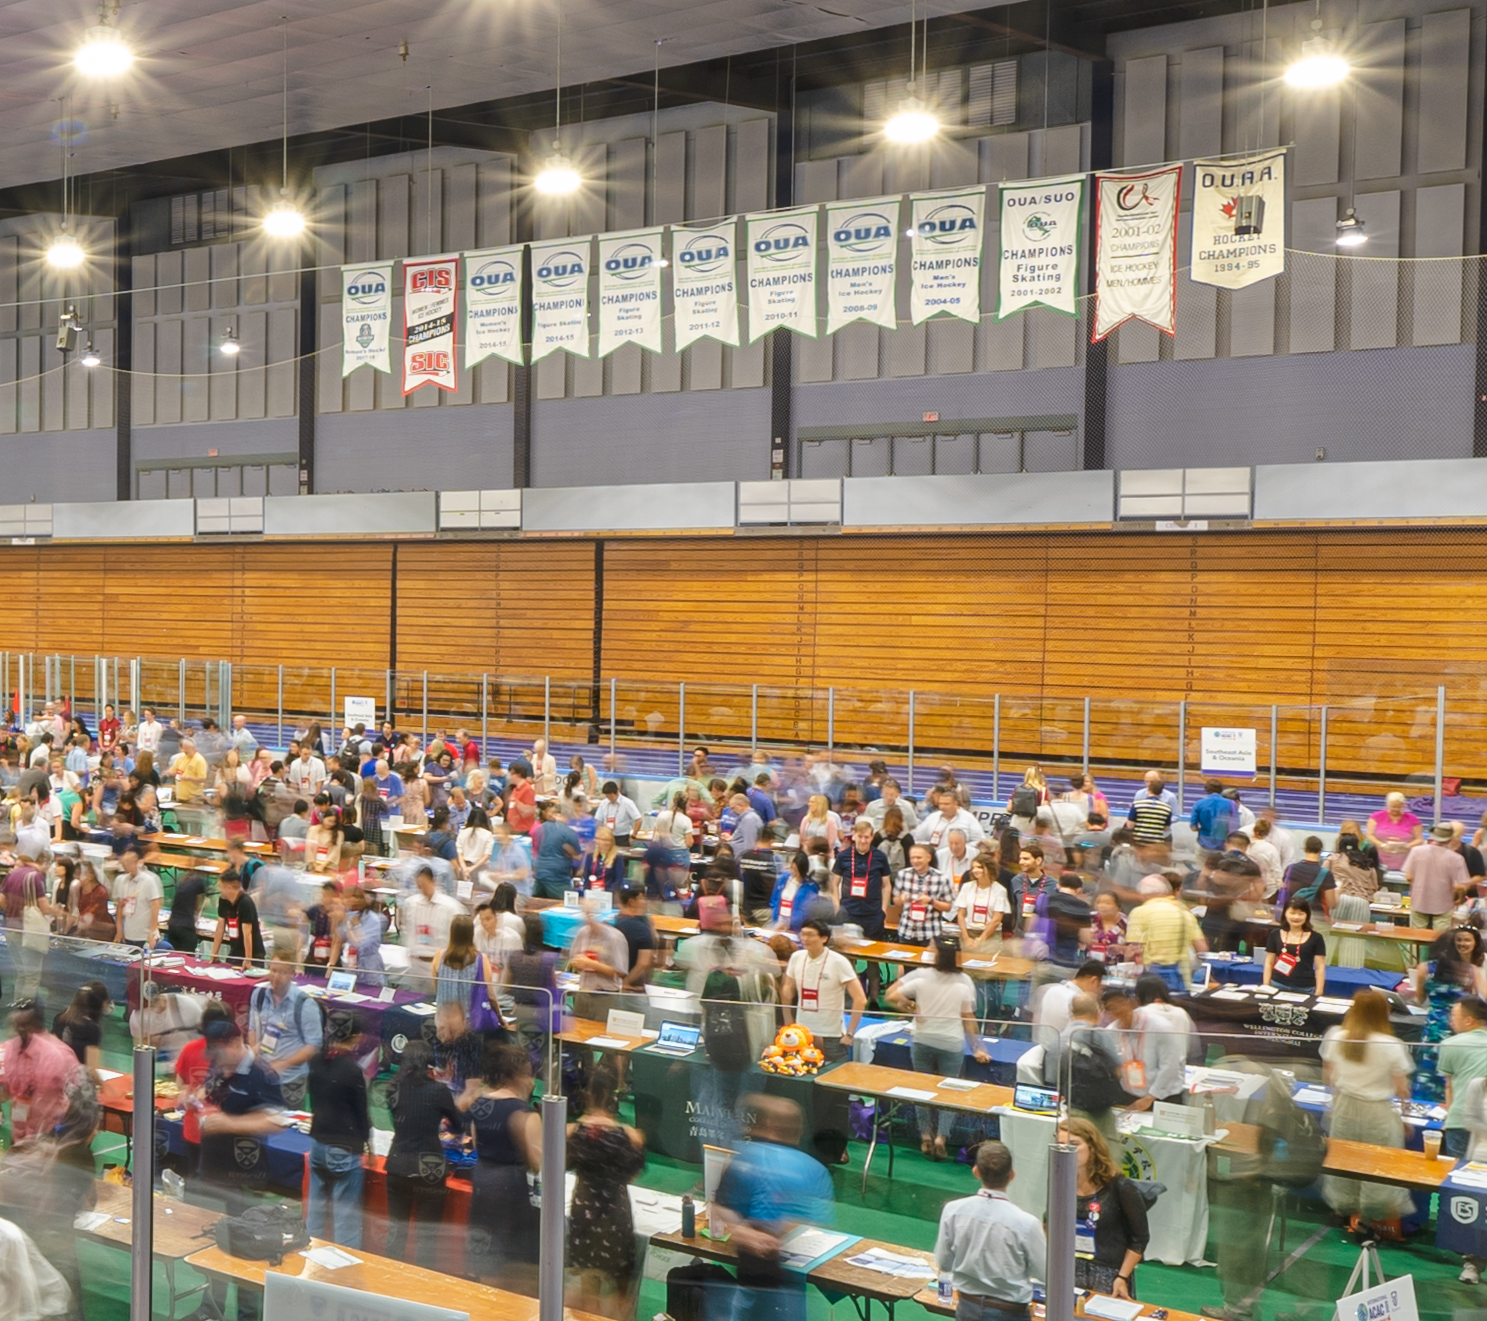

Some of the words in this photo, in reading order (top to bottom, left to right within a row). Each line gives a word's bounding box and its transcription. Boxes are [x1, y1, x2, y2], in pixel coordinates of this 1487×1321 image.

[1007, 192, 1075, 208] OUA/SUO
[918, 218, 977, 234] OUA
[1111, 224, 1162, 239] 2001-02
[834, 226, 891, 243] OUA
[1213, 234, 1262, 246] HOCKEY
[754, 236, 809, 253] OUA
[1110, 240, 1160, 252] CHAMPIONS
[1198, 244, 1276, 260] CHAMPIONS
[680, 246, 729, 263] OUA
[1003, 245, 1073, 260] CHAMPIONS
[537, 263, 584, 278] OUA
[605, 255, 653, 271] OUA
[913, 257, 979, 271] CHAMPIONS
[1017, 263, 1058, 274] Figure
[1110, 264, 1122, 274] ICE
[1125, 261, 1160, 273] HOCKEY
[411, 269, 451, 289] CIS
[831, 264, 894, 279] CHAMPIONS
[1012, 272, 1062, 283] Skating
[471, 272, 515, 287] OUA
[750, 272, 813, 288] CHAMPIONS
[936, 282, 966, 290] Hockey
[347, 283, 385, 296] OUA
[675, 282, 733, 297] CHAMPIONS
[770, 290, 794, 298] Figure
[854, 288, 883, 296] Hockey
[1010, 287, 1062, 297] 2001-2002
[533, 299, 584, 311] CHAMPION
[601, 291, 657, 305] CHAMPIONS
[346, 312, 387, 323] CHAMPIONS
[469, 306, 518, 318] CHAMPIONS
[409, 324, 450, 344] CHAMPIONS
[411, 351, 449, 372] SIC
[1369, 1303, 1384, 1320] ACAC
